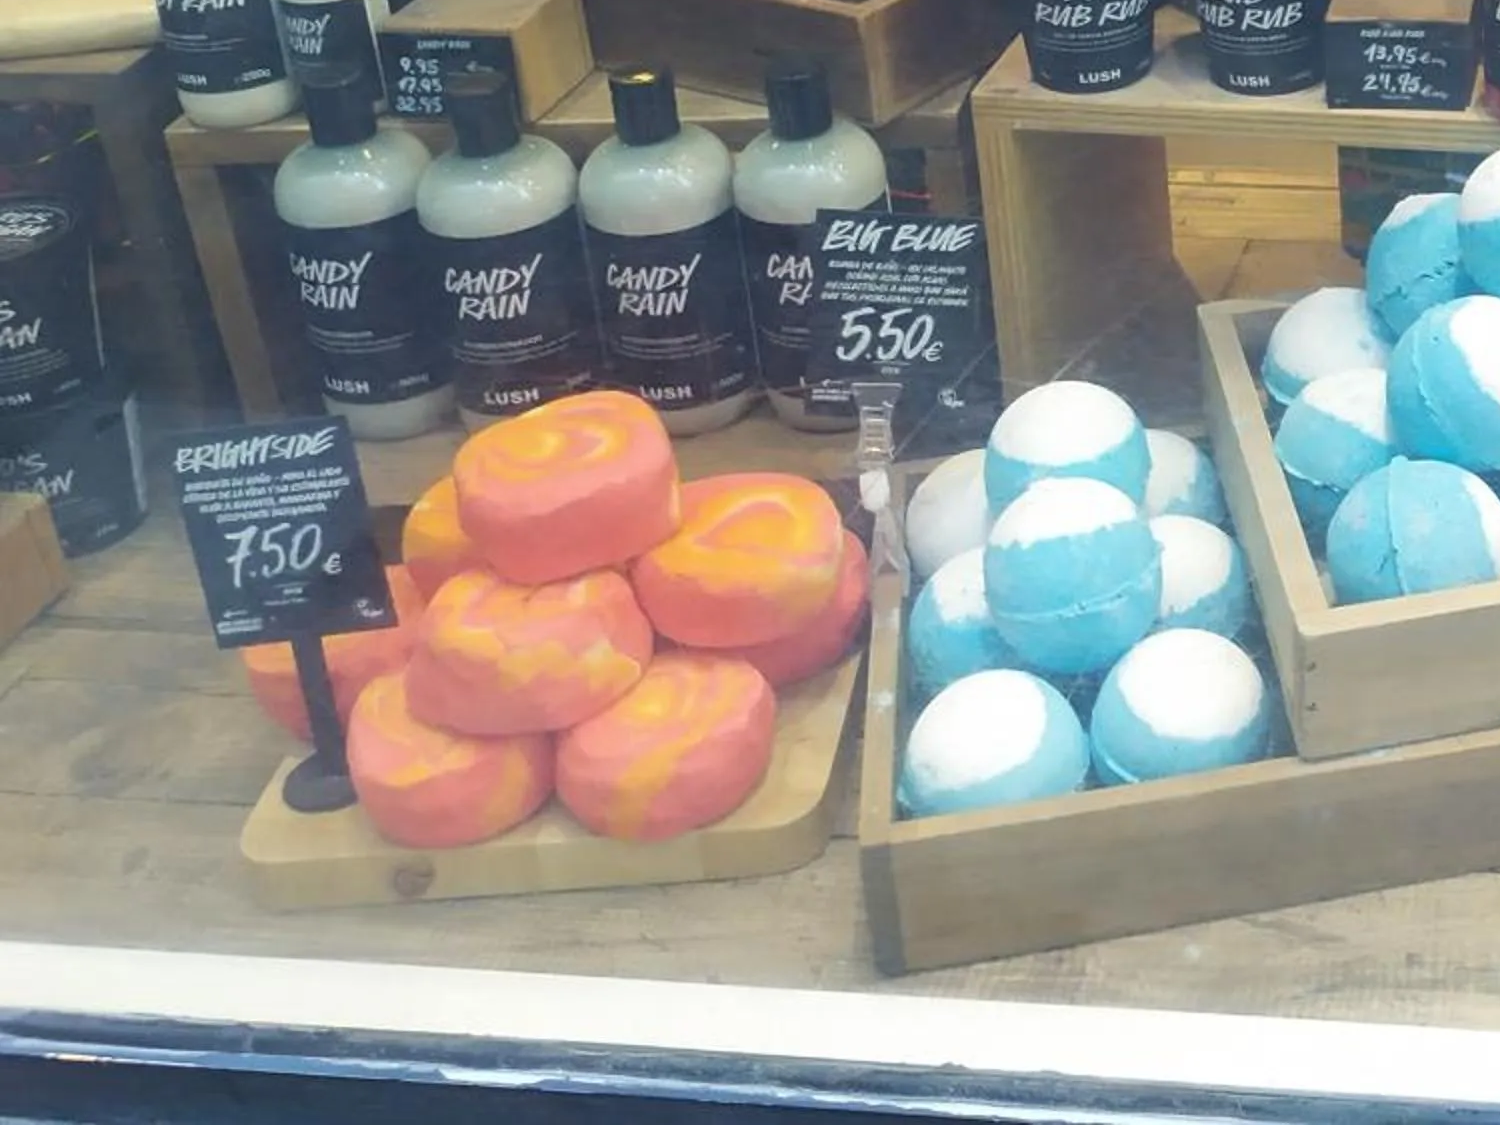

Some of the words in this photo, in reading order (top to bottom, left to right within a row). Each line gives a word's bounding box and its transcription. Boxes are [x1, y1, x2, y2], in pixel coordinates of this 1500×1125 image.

[1035, 2, 1093, 27] RUB
[1241, 0, 1303, 32] RUB
[1079, 68, 1121, 84] LUSH
[1229, 73, 1271, 87] LUSH
[821, 219, 892, 254] BIG
[891, 223, 978, 252] BLUE
[290, 251, 374, 285] CANDY
[445, 253, 543, 295] CANDY
[606, 253, 702, 292] CANDY
[767, 253, 813, 280] CAN
[301, 283, 360, 310] RAIN
[459, 289, 532, 321] RAIN
[618, 287, 688, 317] RAIN
[324, 376, 371, 395] LUSH
[483, 387, 541, 406] LUSH
[639, 383, 693, 401] LUSH
[174, 426, 339, 474] BRIGHTSIDE
